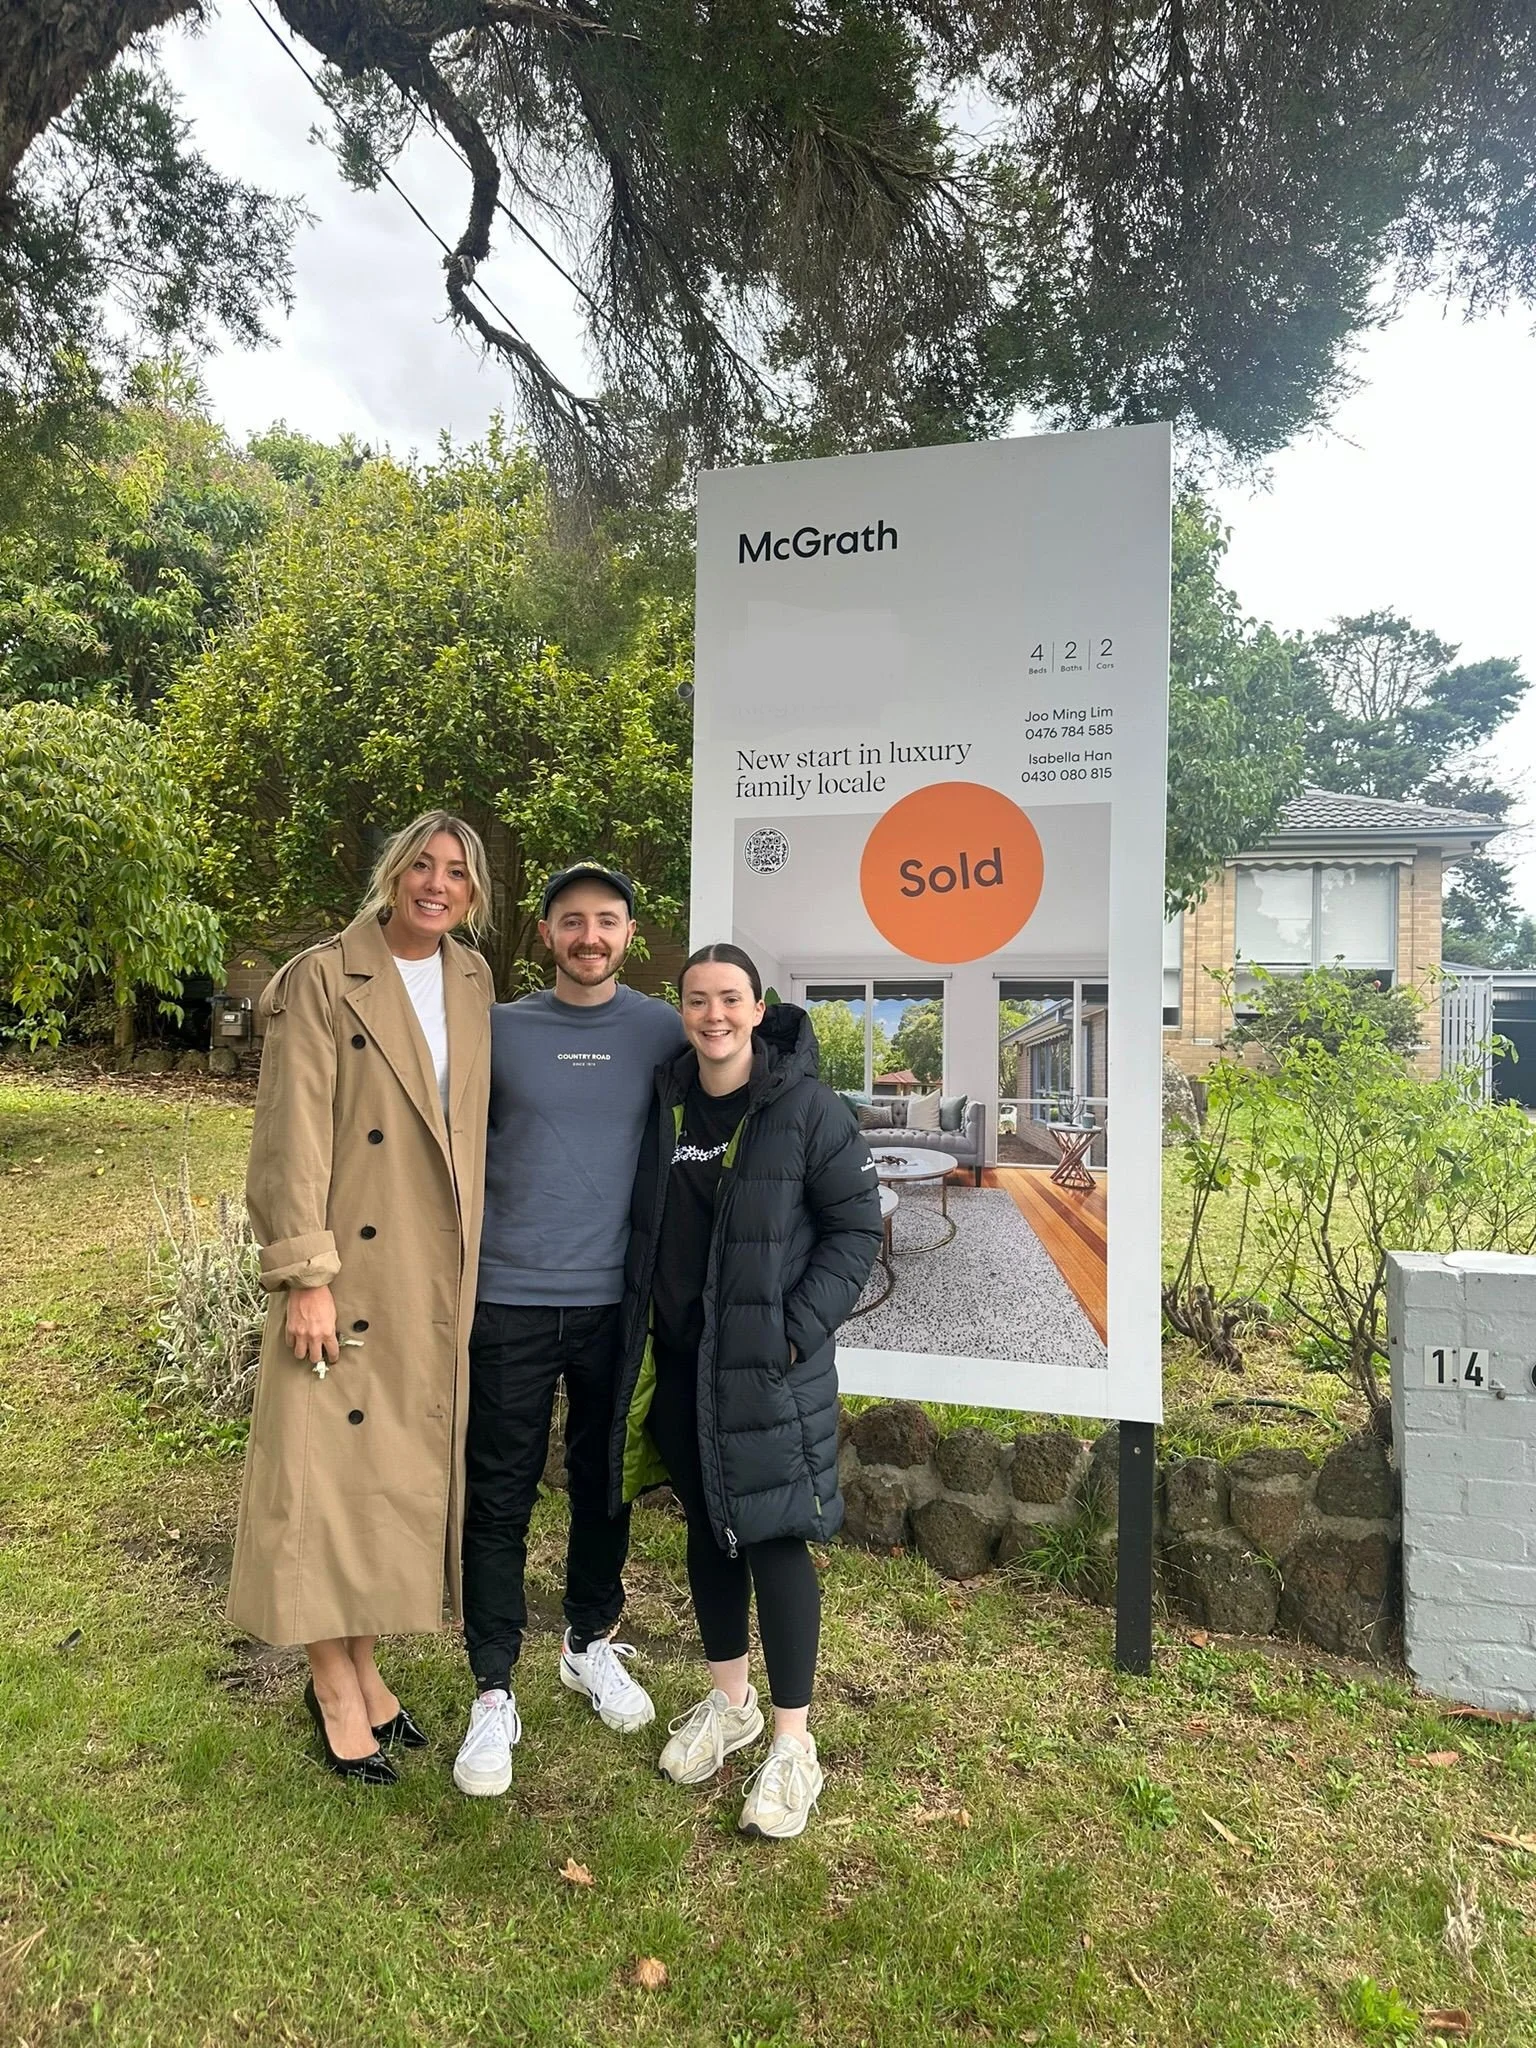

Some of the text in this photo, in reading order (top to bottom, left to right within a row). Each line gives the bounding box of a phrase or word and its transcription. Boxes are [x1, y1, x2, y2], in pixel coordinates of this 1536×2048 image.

[739, 519, 898, 564] McGrath
[1030, 638, 1113, 661] 4 2 2
[1028, 662, 1114, 675] Beds Baths Cars
[1024, 706, 1114, 723] Joo Ming Lim
[1025, 723, 1113, 741] 0476 784 585
[736, 740, 973, 772] New start in luxury
[1028, 749, 1113, 765] Isabella Han
[735, 770, 887, 801] family locale
[1021, 767, 1113, 783] 0430 080 815
[899, 847, 1004, 898] Sold
[1432, 1349, 1484, 1387] 14
